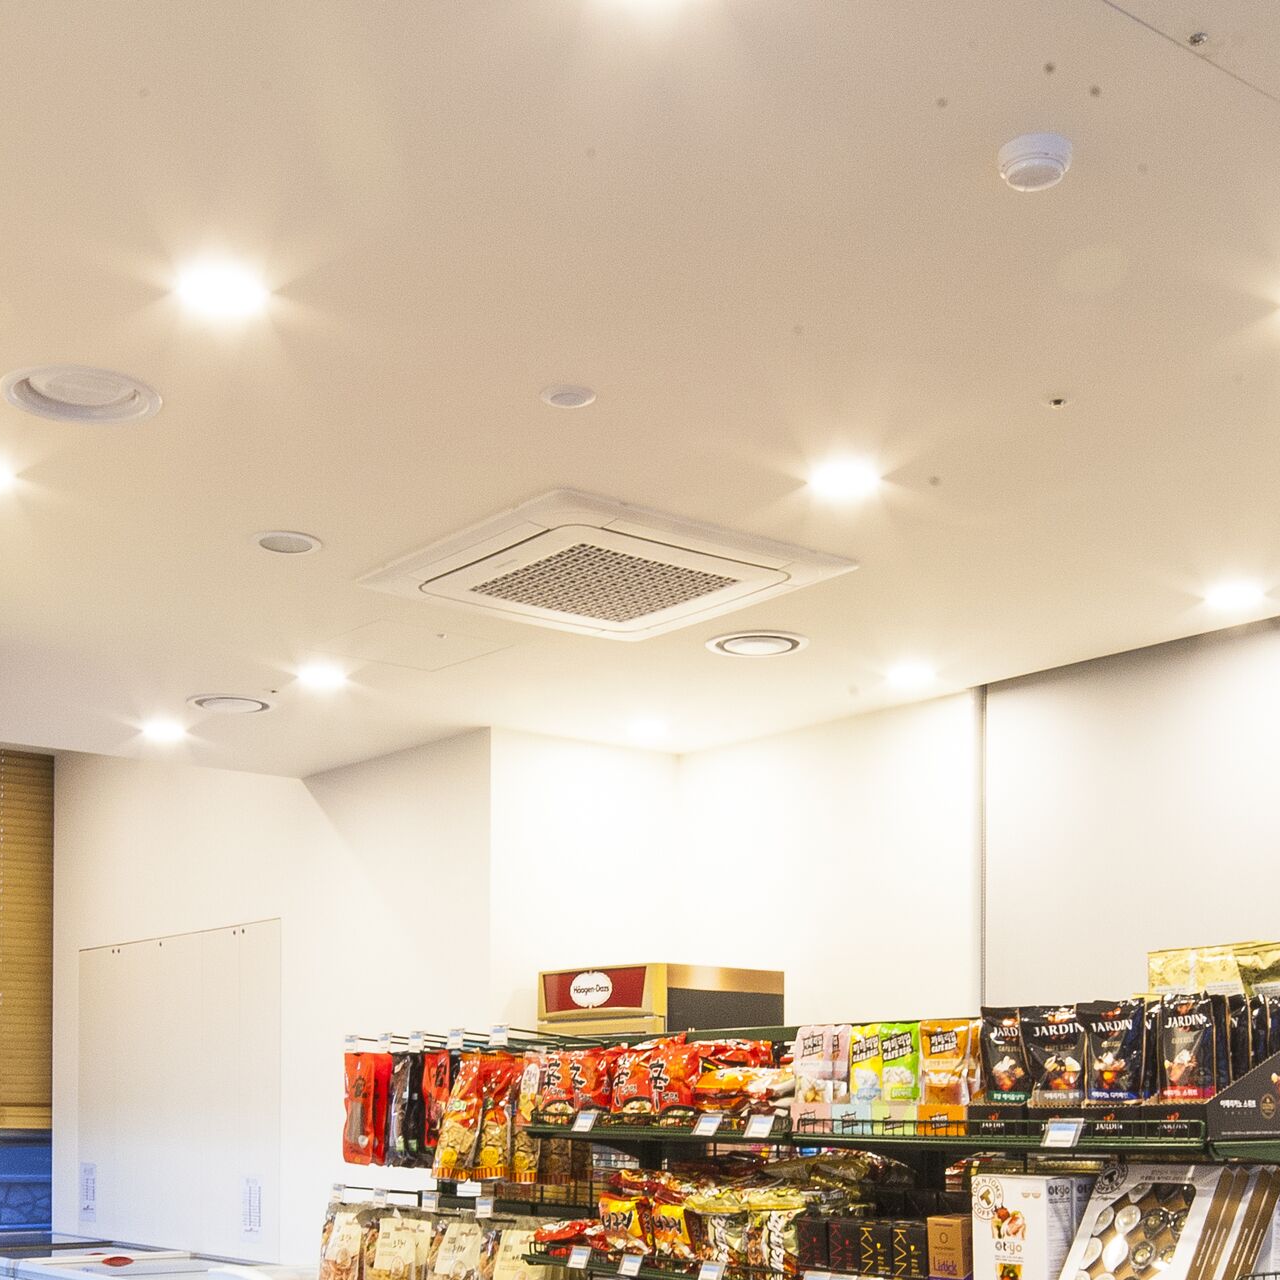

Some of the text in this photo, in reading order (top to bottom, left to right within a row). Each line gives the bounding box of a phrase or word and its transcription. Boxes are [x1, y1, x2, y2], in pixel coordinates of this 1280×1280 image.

[573, 983, 611, 996] Häagen-Dazs
[1091, 1019, 1133, 1034] JARDIN
[1164, 1012, 1207, 1029] JARDIN
[1033, 1021, 1084, 1038] JARDIN
